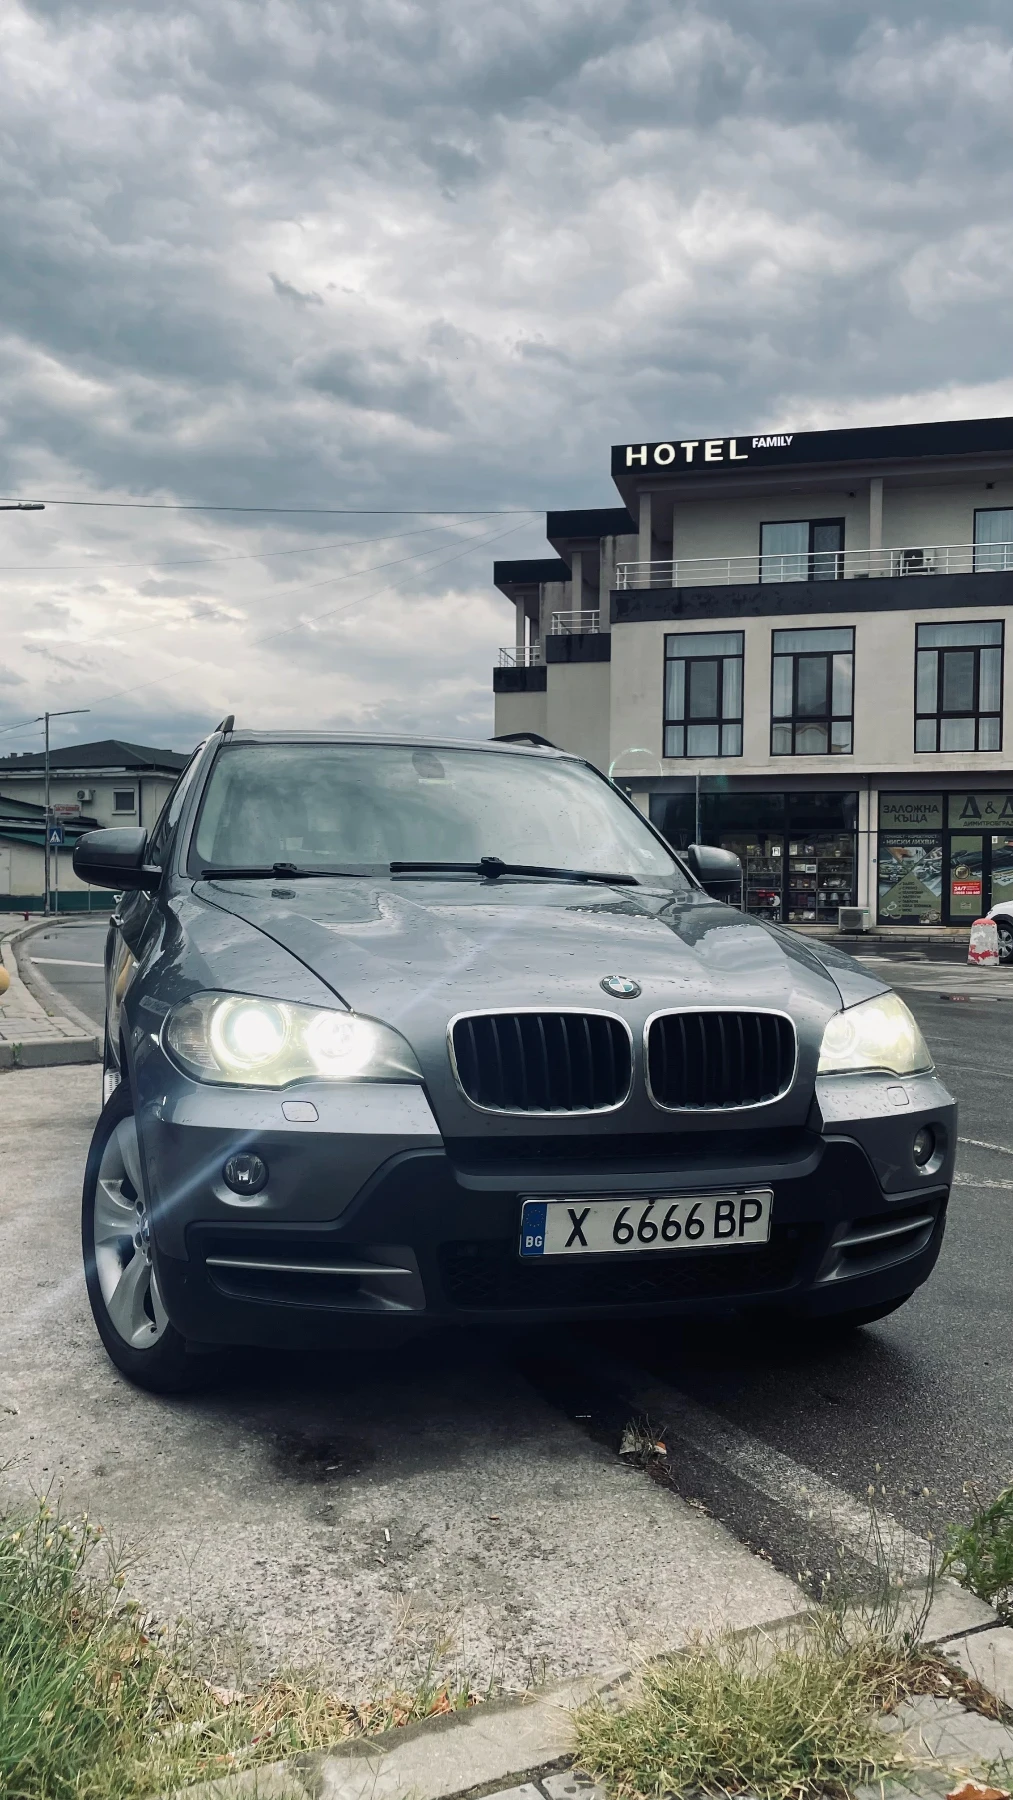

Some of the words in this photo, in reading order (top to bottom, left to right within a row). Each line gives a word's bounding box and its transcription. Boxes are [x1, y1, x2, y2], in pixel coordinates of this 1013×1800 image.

[625, 439, 749, 467] HOTEL
[752, 436, 794, 449] FAMILY
[883, 804, 940, 814] ЗАЛОЖНА
[959, 796, 982, 820] Д
[984, 801, 998, 814] &
[894, 814, 928, 824] КЪЩА
[564, 1207, 591, 1248] X
[612, 1202, 705, 1245] 6666
[713, 1198, 763, 1239] BP
[525, 1235, 543, 1248] BG
